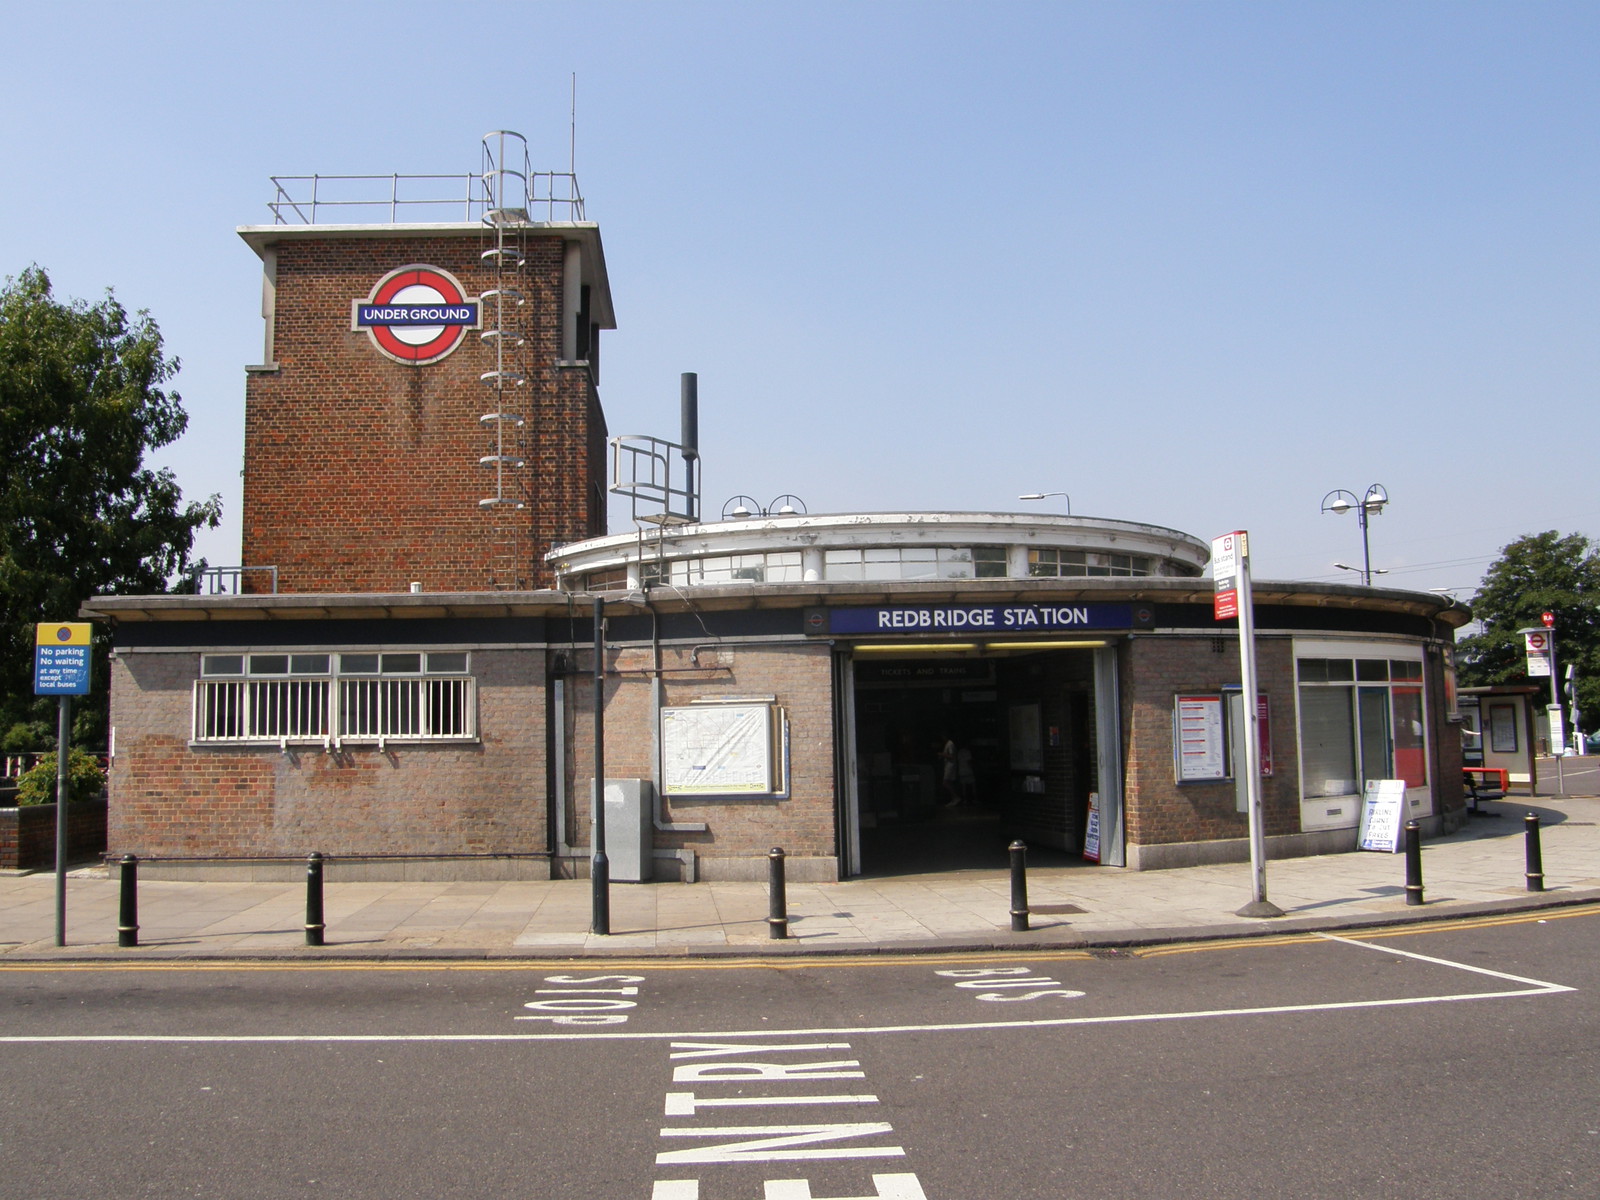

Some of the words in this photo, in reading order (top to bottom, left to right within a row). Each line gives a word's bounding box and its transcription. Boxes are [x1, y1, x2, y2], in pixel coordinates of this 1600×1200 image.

[364, 308, 470, 320] UNDERGROUND
[878, 609, 995, 628] REDBRIDGE
[1003, 607, 1089, 626] STATION
[55, 648, 84, 657] parking
[55, 658, 84, 667] waiting
[880, 668, 911, 677] TICKETS
[916, 667, 934, 676] AND
[939, 666, 967, 675] TRAINS
[934, 967, 1087, 1001] BUS
[513, 975, 646, 1025] STOP
